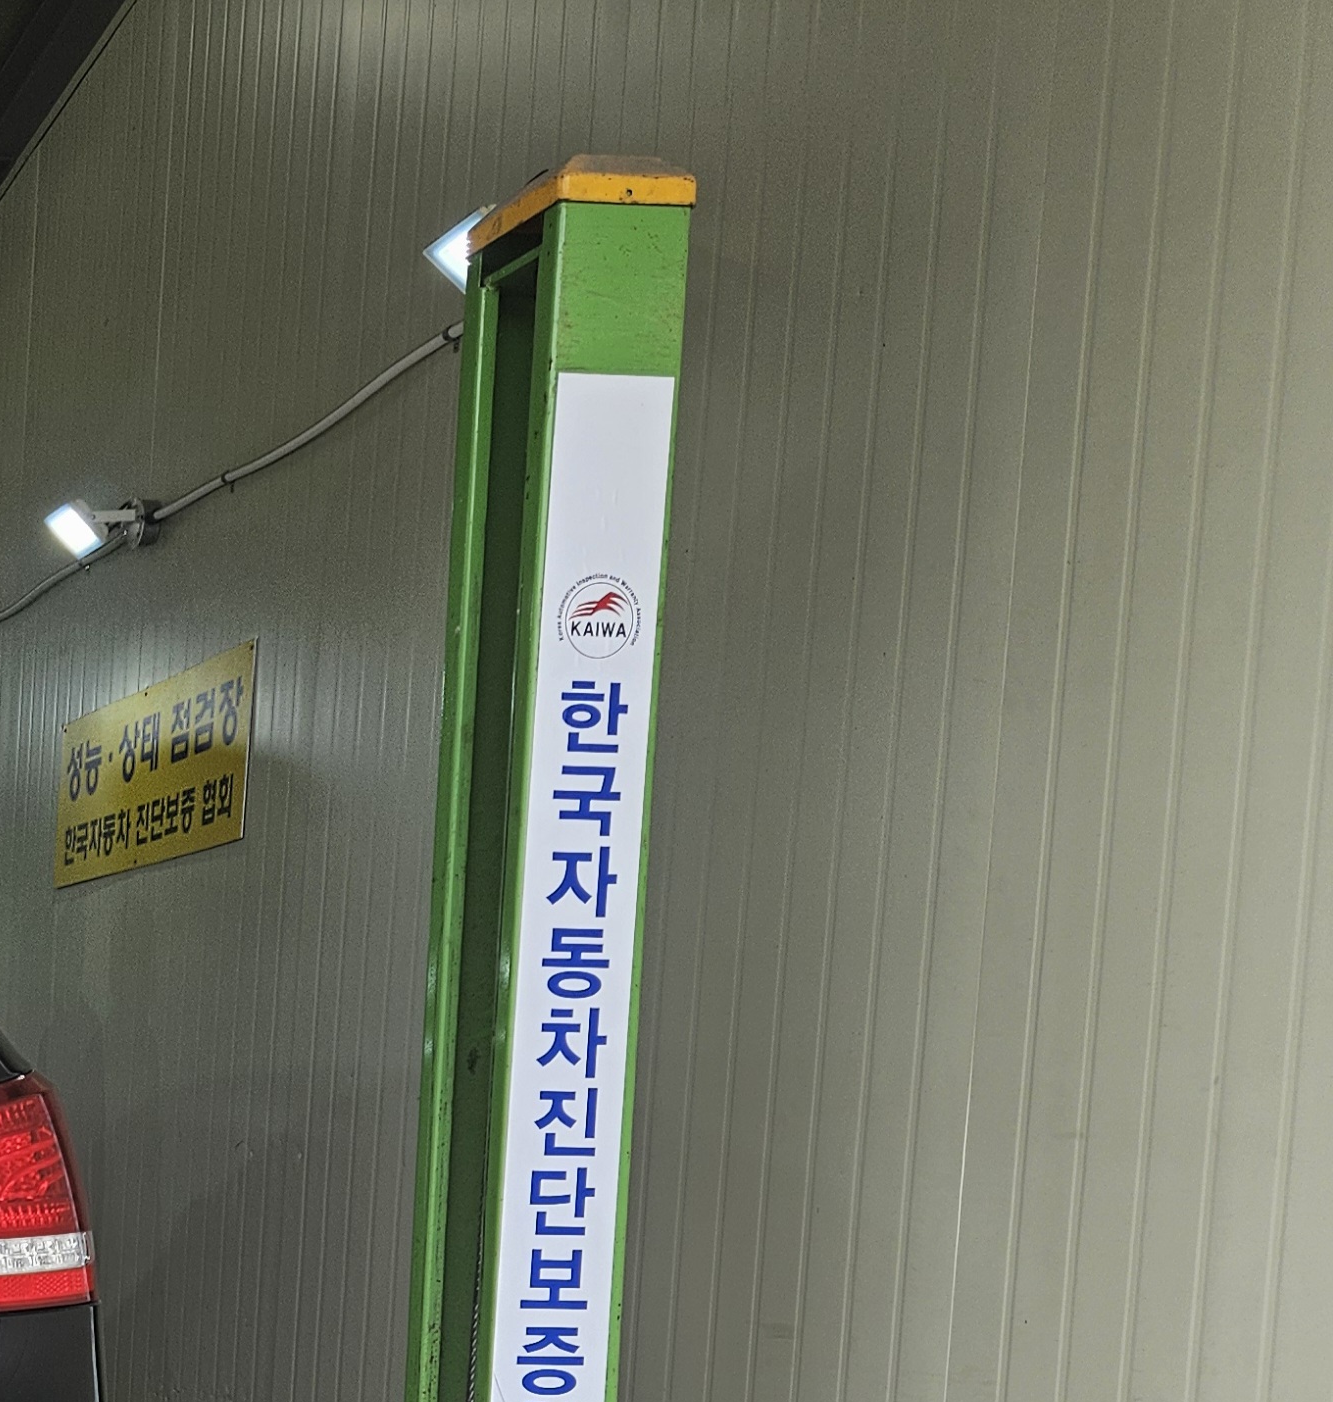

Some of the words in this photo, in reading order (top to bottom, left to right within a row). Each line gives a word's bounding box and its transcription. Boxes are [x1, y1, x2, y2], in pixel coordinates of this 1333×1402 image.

[576, 573, 608, 586] Inspection
[609, 575, 620, 583] and
[570, 621, 627, 638] KAIWA
[171, 676, 244, 764] 점검장
[64, 809, 131, 866] 한국자동차
[136, 787, 196, 846] 진단보증
[202, 773, 233, 827] 협회
